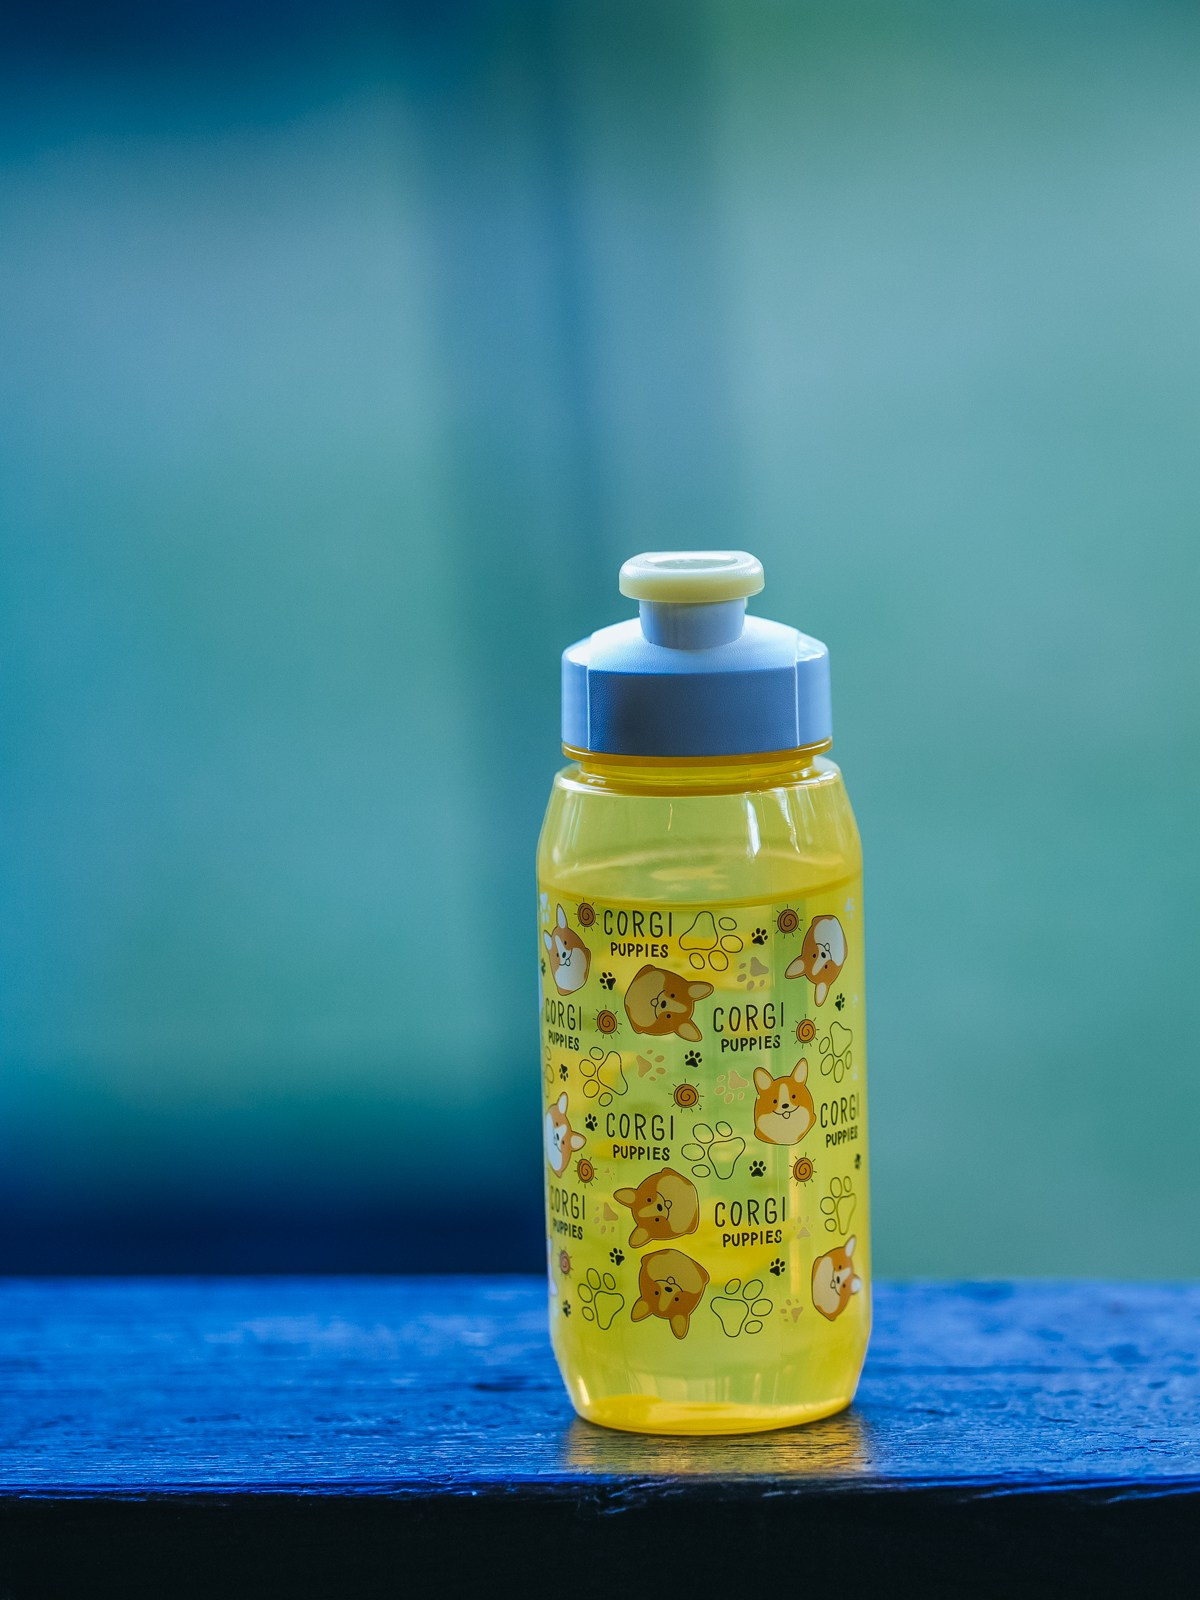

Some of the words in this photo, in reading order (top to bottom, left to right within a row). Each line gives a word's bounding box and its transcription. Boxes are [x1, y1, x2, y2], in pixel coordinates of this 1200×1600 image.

[603, 910, 673, 938] CORGI
[610, 942, 669, 959] PUPPIES
[545, 998, 582, 1031] CORGI
[713, 1002, 785, 1033] CORGI
[548, 1029, 580, 1051] PUPPIES
[721, 1035, 781, 1053] PUPPIES
[821, 1093, 860, 1128] CORGI
[606, 1112, 675, 1141] CORGI
[826, 1125, 858, 1148] PUPPIES
[613, 1144, 671, 1162] PUPPIES
[714, 1196, 786, 1228] CORGI
[722, 1229, 783, 1248] PUPPIES
